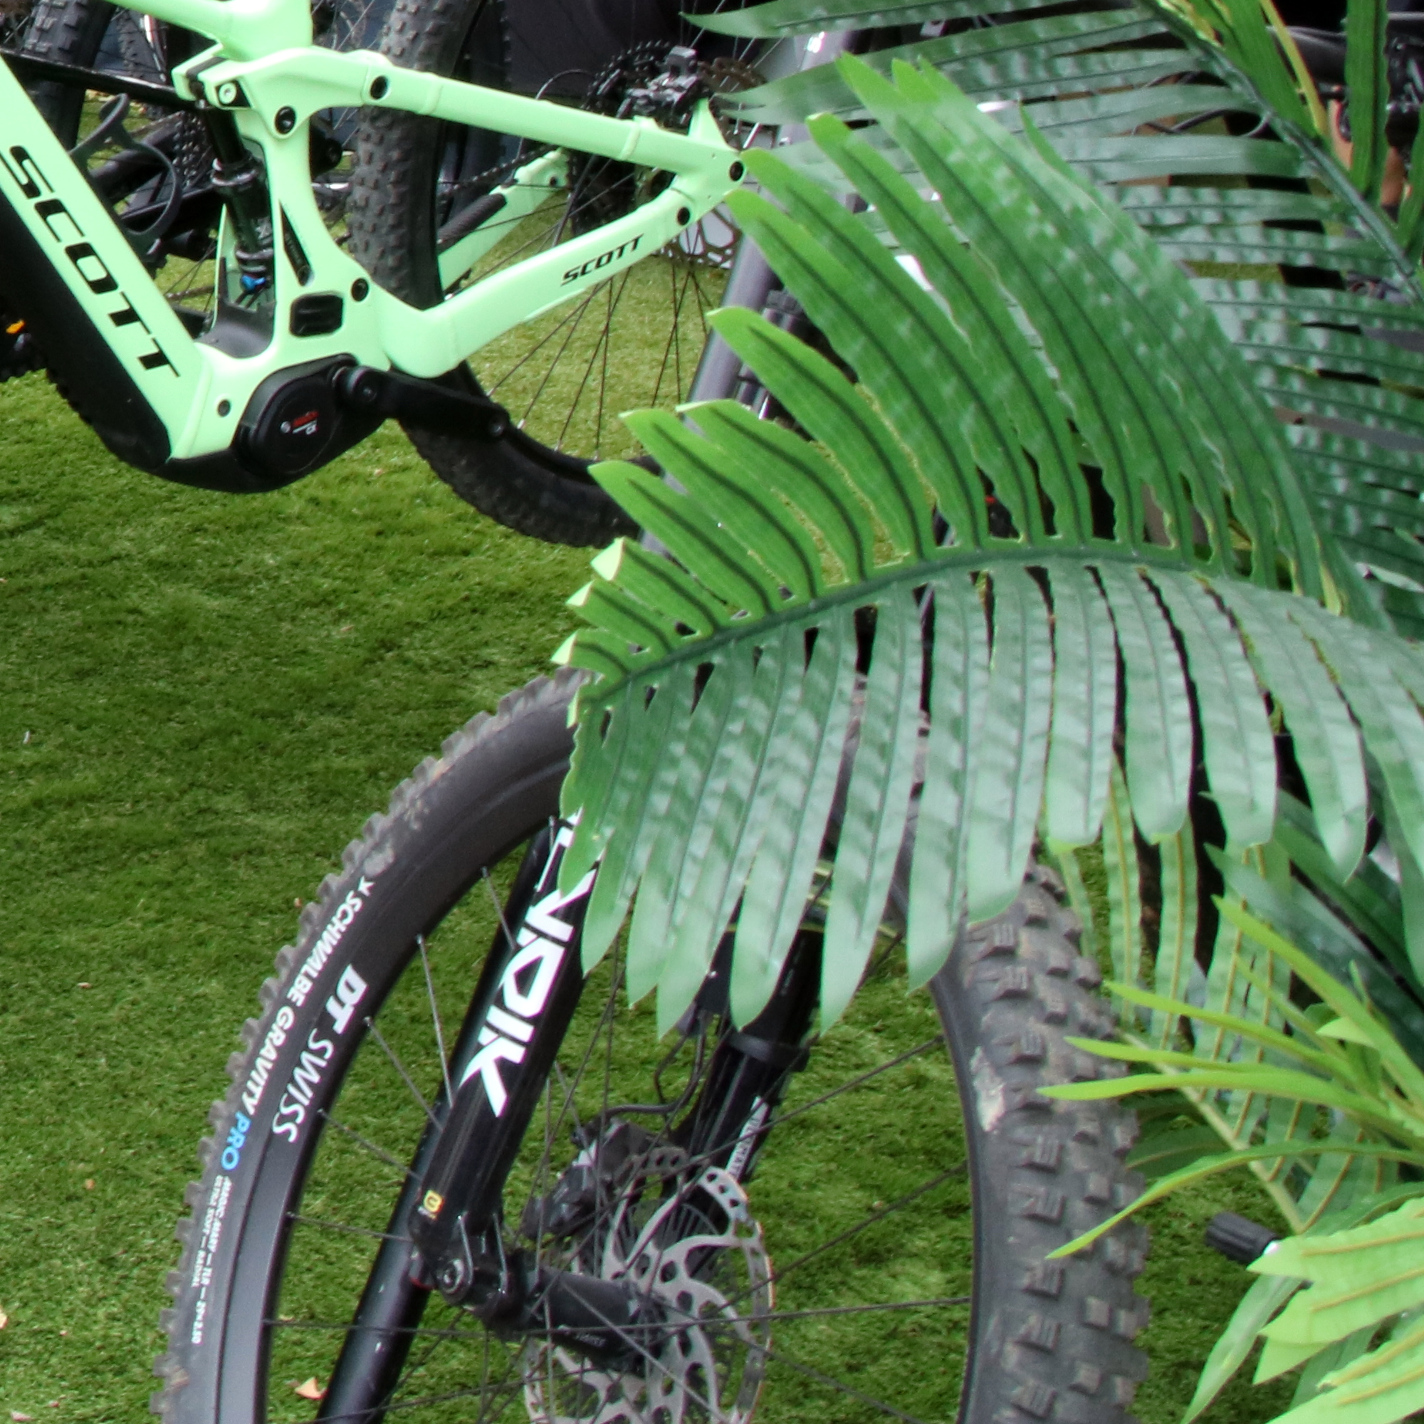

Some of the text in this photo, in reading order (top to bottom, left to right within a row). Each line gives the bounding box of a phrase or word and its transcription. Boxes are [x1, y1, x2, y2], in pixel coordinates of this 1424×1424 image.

[560, 233, 644, 286] SCOTT
[221, 890, 363, 1170] SCHWALBE GRAVITY PRO
[271, 963, 369, 1143] DT SWISS
